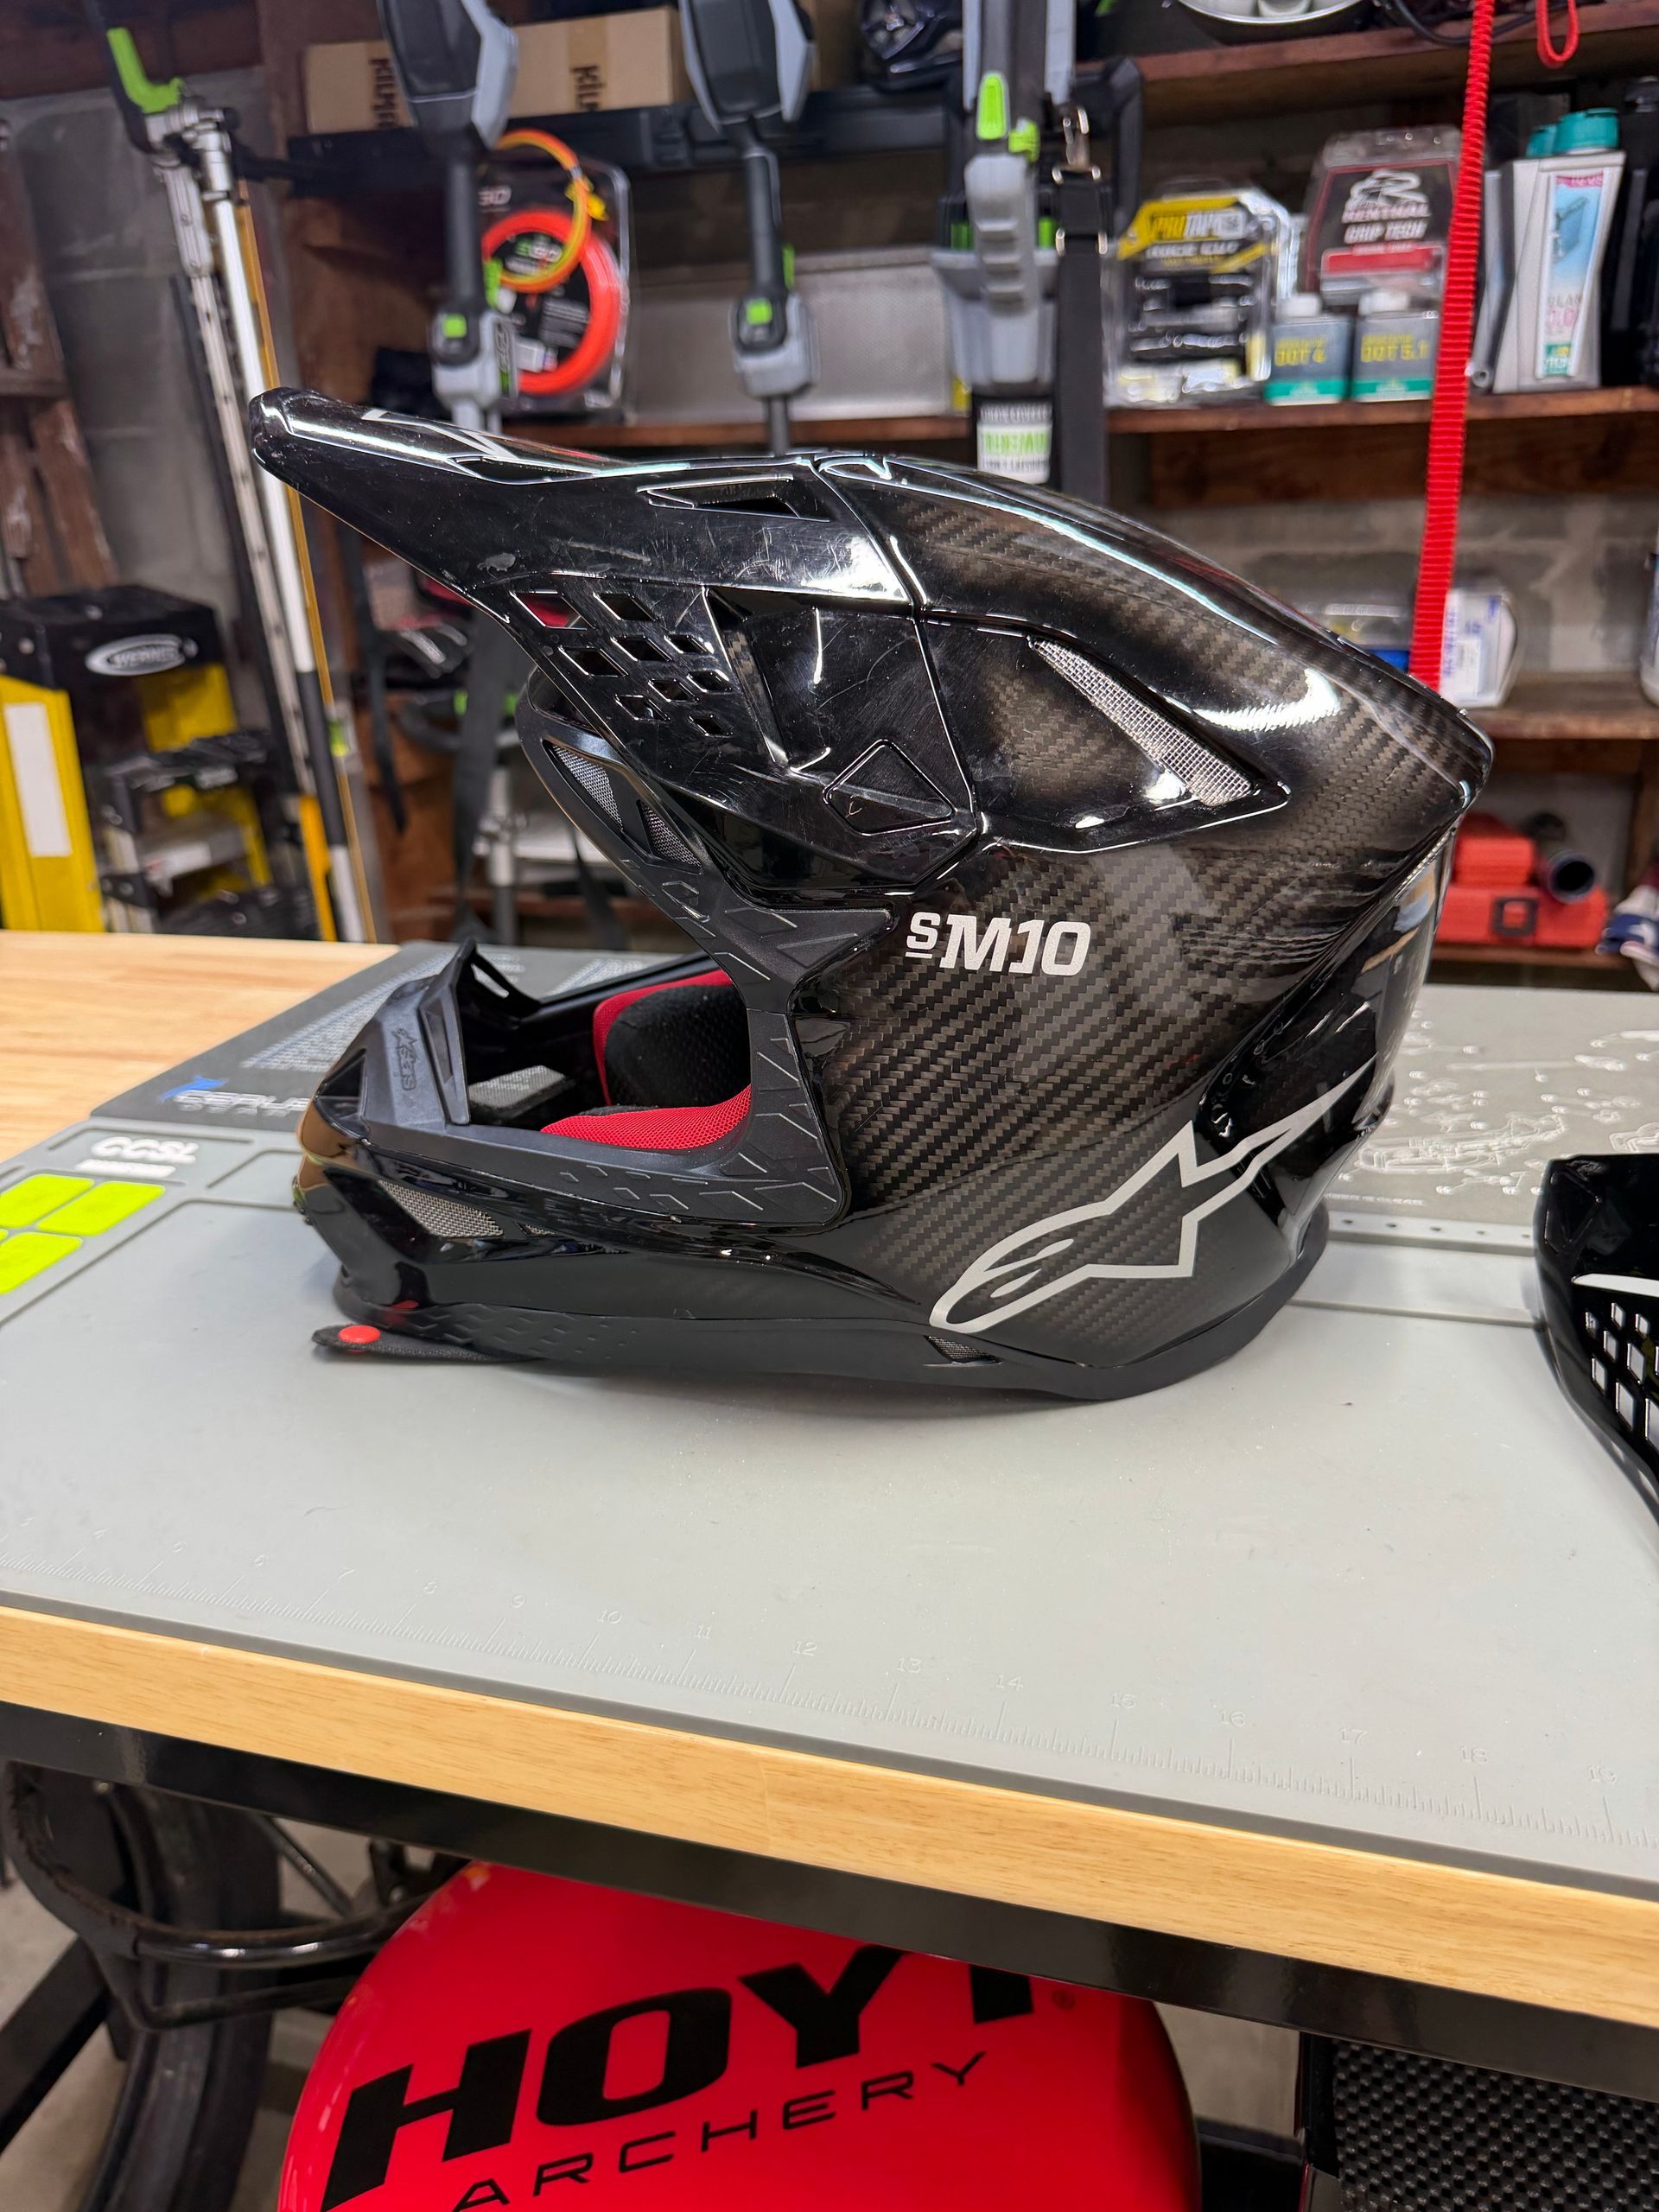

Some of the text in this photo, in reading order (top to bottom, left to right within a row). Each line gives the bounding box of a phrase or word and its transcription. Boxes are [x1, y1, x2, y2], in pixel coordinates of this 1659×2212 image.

[596, 1609, 623, 1624] 10
[694, 1624, 713, 1639] 11
[792, 1640, 818, 1657] 12
[896, 1656, 922, 1674] 13
[995, 1673, 1024, 1692] 14
[1109, 1691, 1138, 1709] 15
[1218, 1708, 1246, 1727] 16
[1339, 1726, 1369, 1745] 17
[1459, 1744, 1491, 1764] 18
[1585, 1763, 1618, 1785] 19
[453, 2052, 986, 2212] ARCHERY
